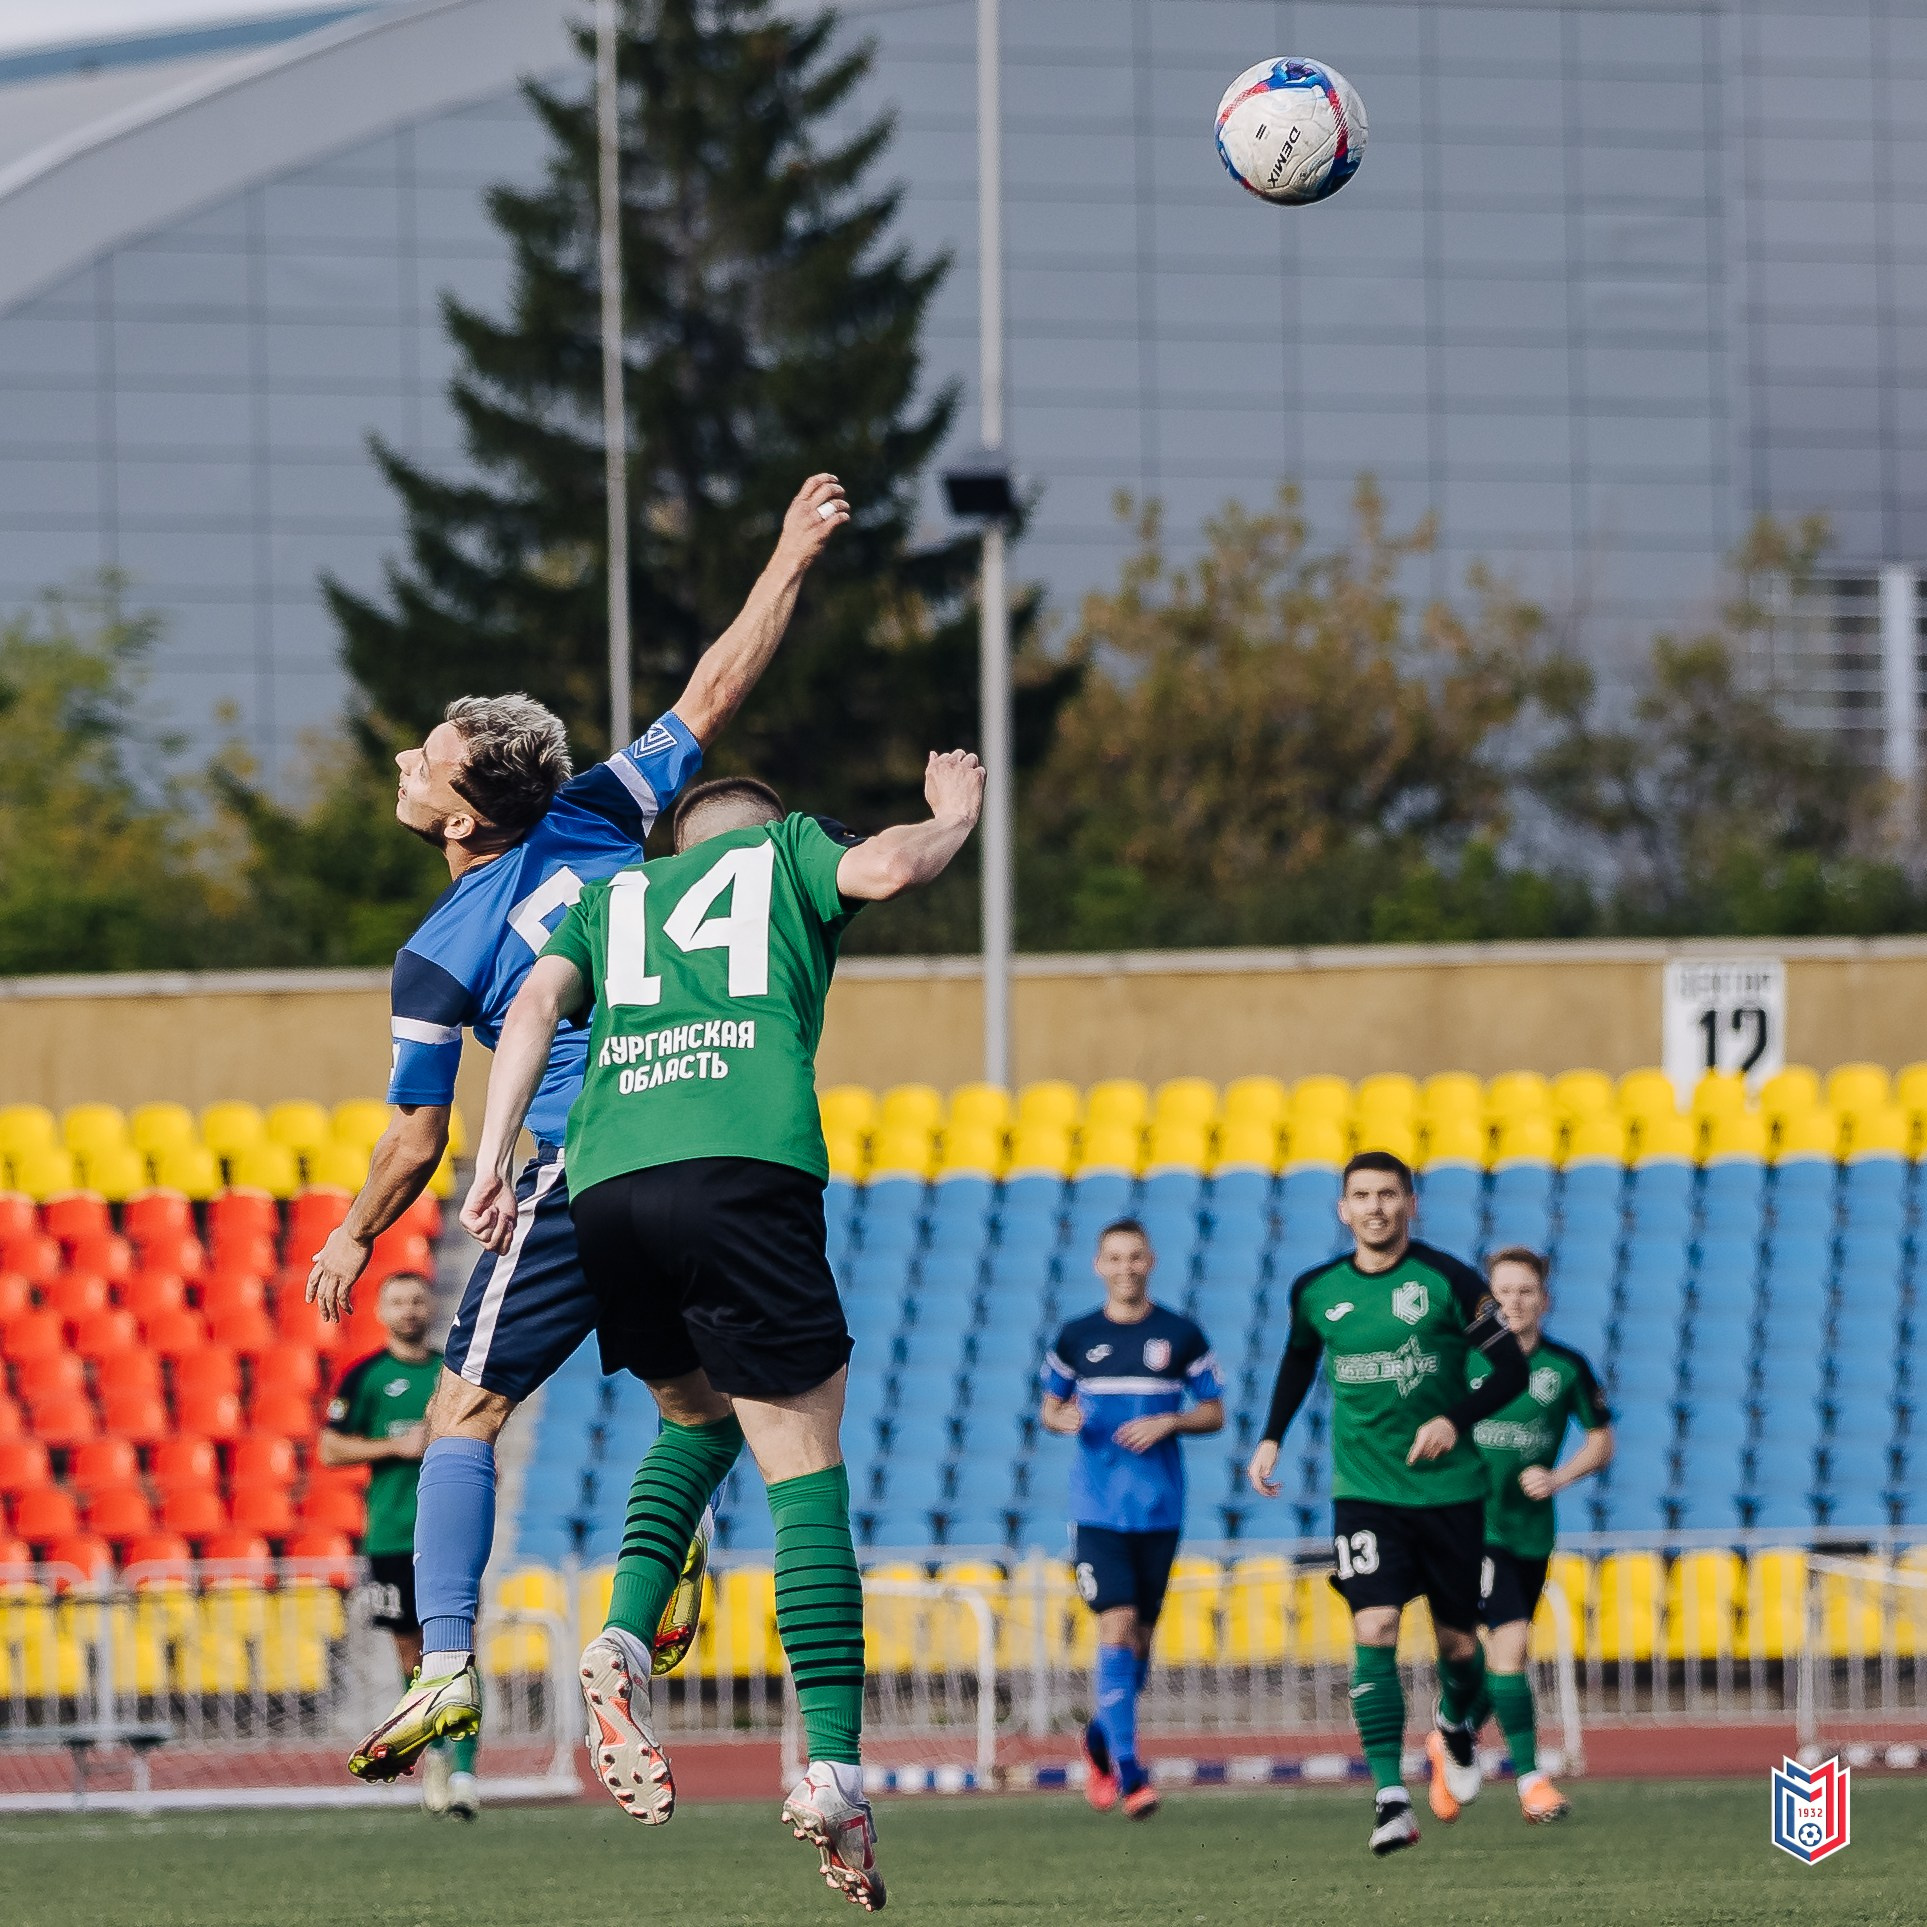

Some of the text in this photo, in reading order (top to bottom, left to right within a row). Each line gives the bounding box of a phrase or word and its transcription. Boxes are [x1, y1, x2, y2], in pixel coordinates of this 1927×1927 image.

[1267, 125, 1301, 188] DEMIX
[604, 838, 775, 1009] 14
[1700, 1009, 1767, 1072] 12
[617, 1051, 730, 1096] ОБЛАСТЬ
[1334, 1529, 1380, 1580] 13
